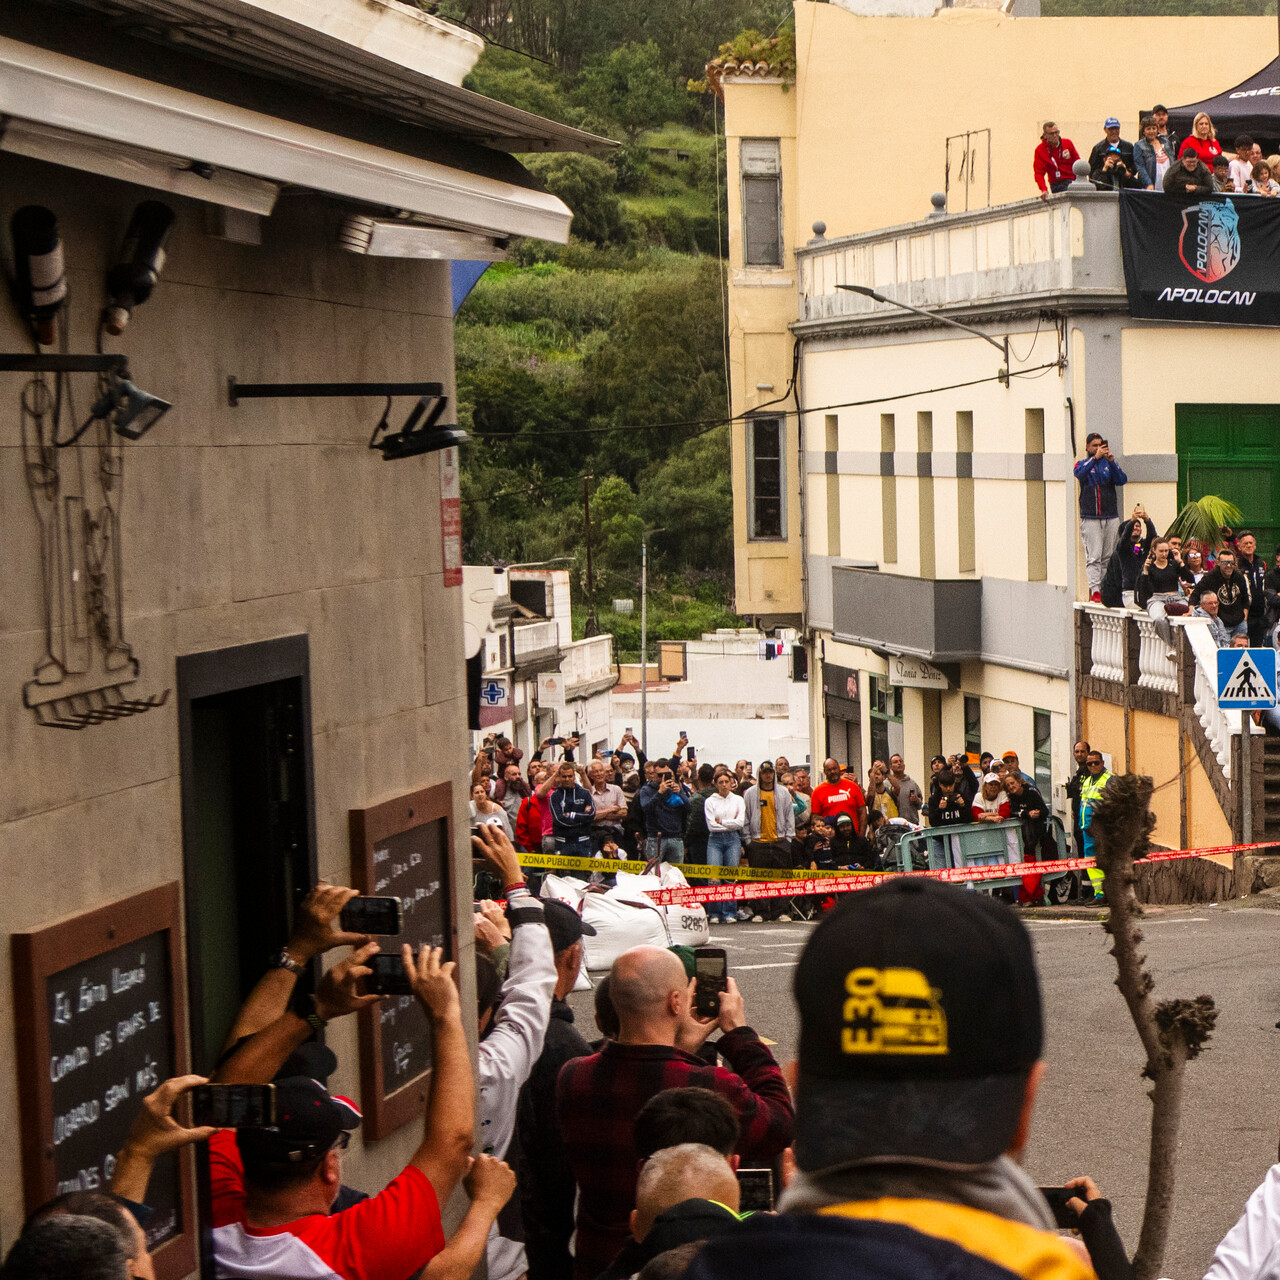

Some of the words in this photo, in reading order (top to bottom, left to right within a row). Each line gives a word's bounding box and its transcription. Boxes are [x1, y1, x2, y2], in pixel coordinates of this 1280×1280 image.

[1157, 287, 1257, 306] APOLOCAN
[828, 794, 848, 803] PUMA
[522, 855, 545, 866] ZONA
[546, 857, 581, 868] PUBLICO
[588, 860, 611, 870] ZONA
[718, 867, 741, 878] ZONA
[741, 868, 774, 879] PUBLICO
[681, 888, 693, 896] ZONA
[695, 886, 716, 894] PROHIBIDO
[716, 885, 734, 893] PUBLICO
